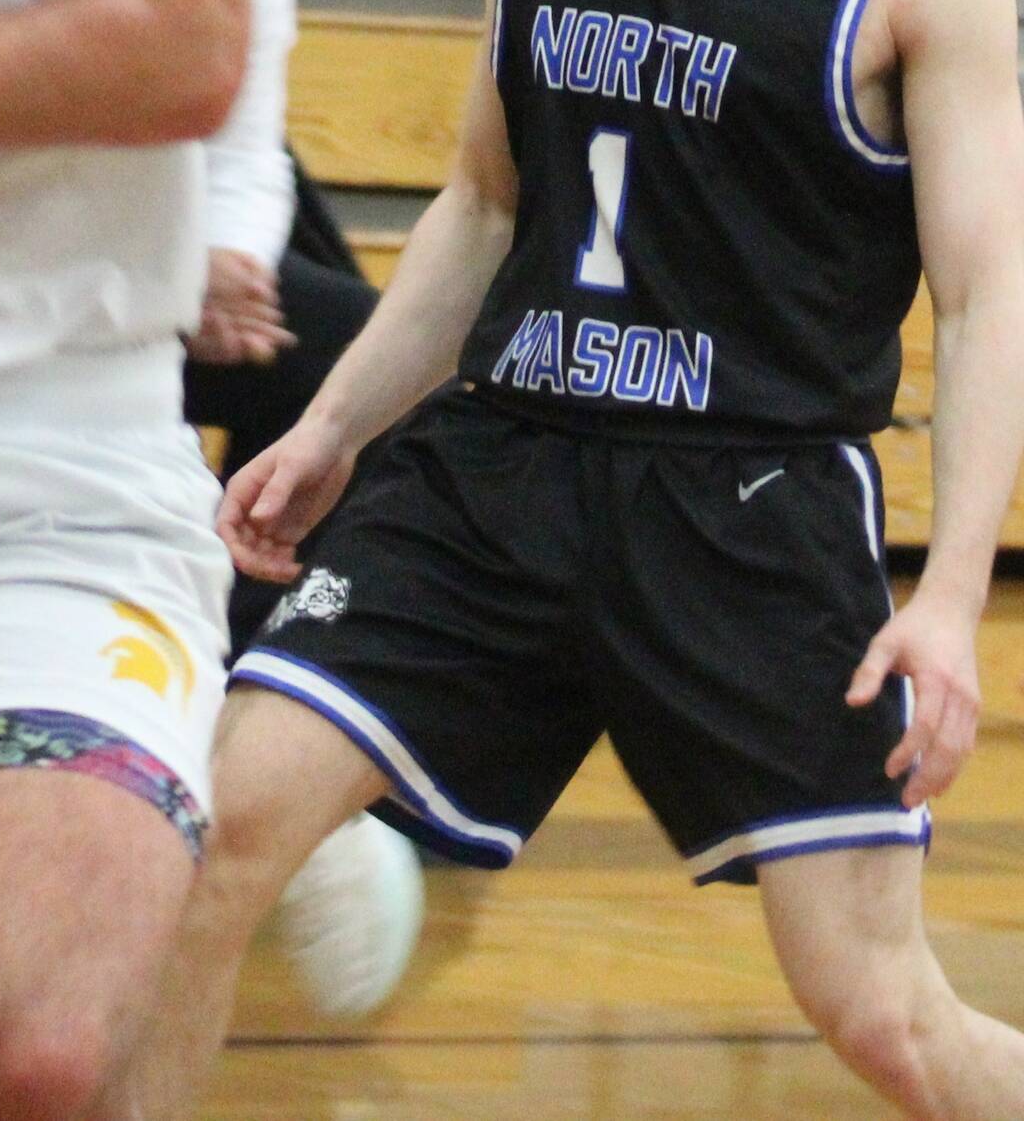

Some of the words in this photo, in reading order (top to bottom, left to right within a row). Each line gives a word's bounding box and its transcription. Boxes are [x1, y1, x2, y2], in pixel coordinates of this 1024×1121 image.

[531, 5, 737, 122] NORTH
[574, 126, 633, 293] 1
[491, 309, 713, 412] MASON
